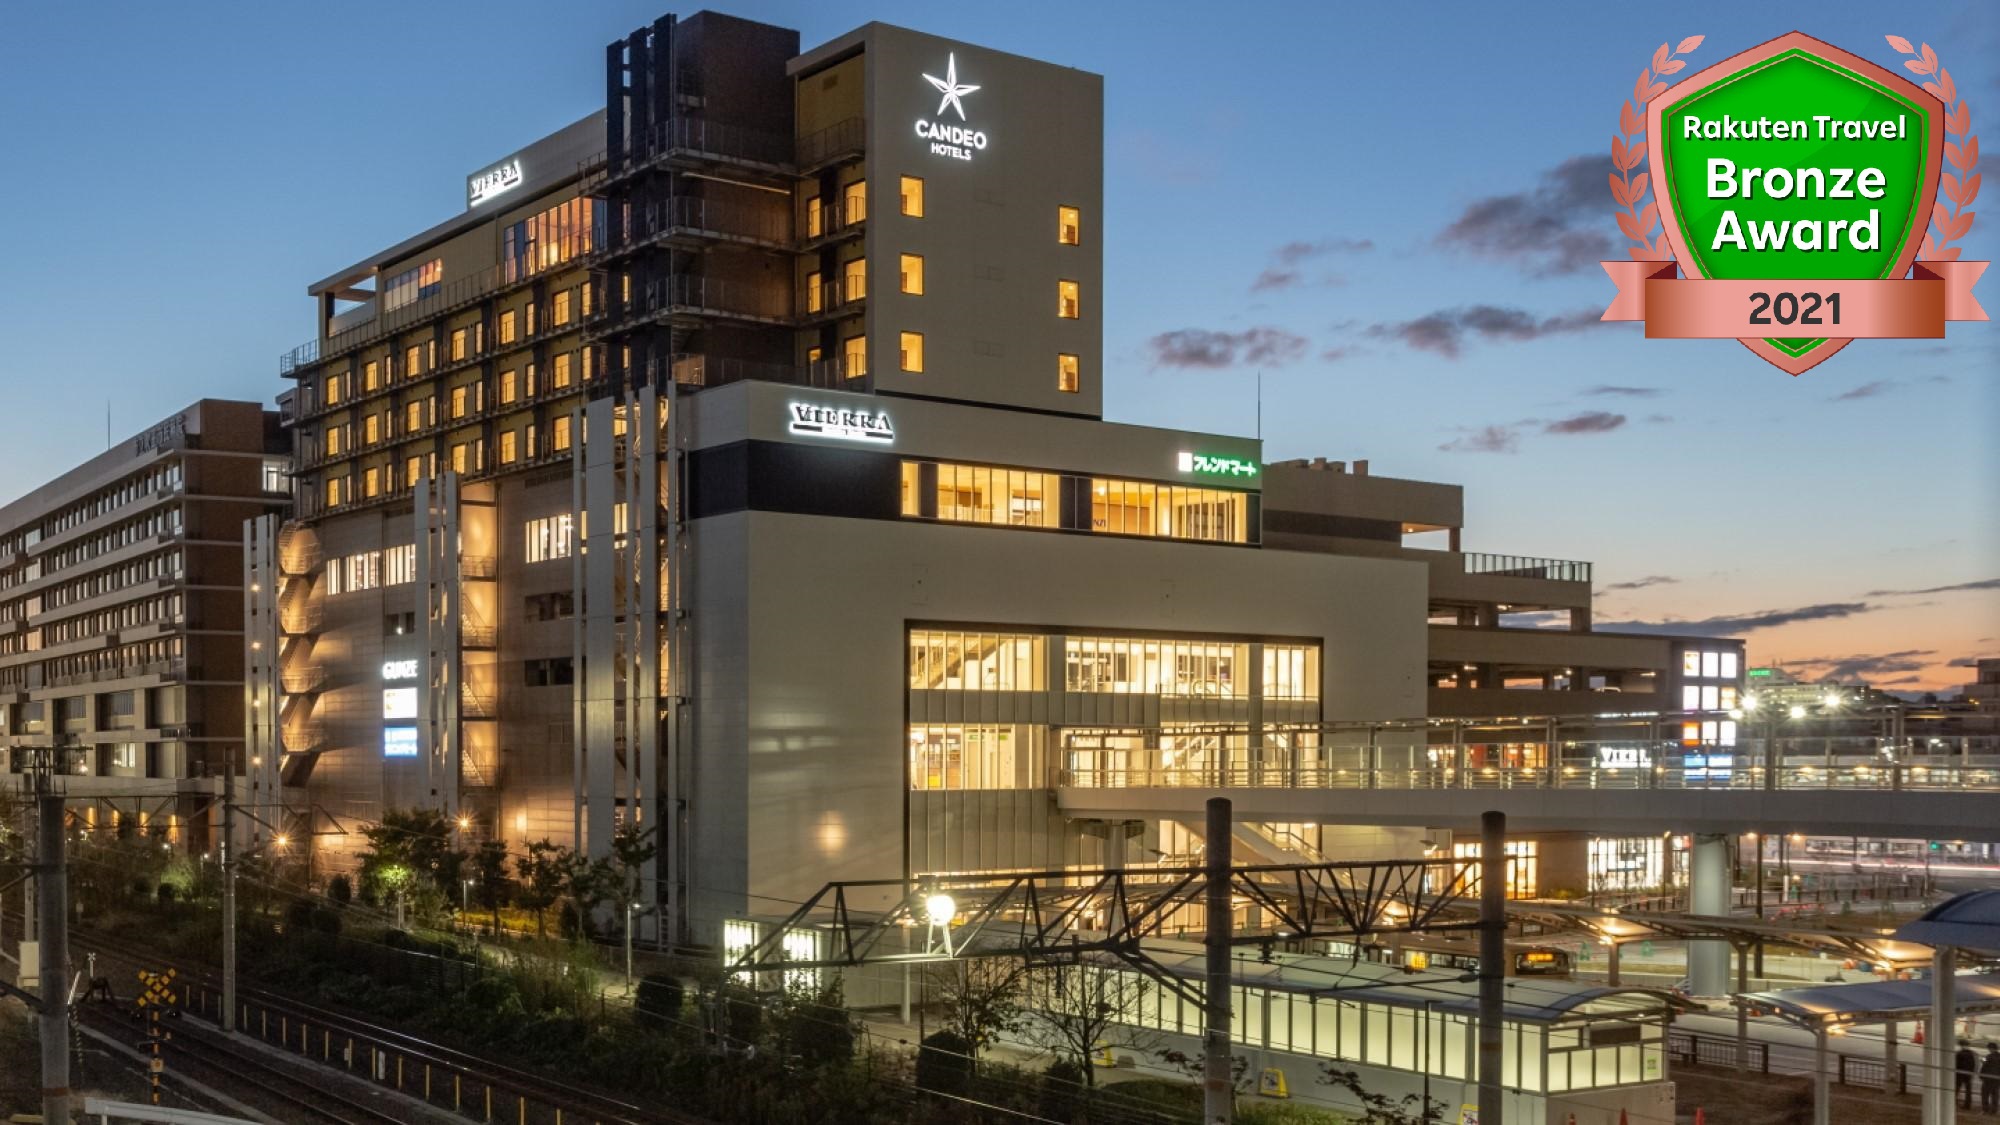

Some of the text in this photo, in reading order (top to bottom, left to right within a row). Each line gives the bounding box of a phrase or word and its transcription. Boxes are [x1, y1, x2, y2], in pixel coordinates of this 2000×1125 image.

[915, 119, 987, 150] CANDEO
[931, 142, 972, 161] HOTELS
[791, 402, 894, 432] VIERRA
[1193, 455, 1257, 477] フレンドマート
